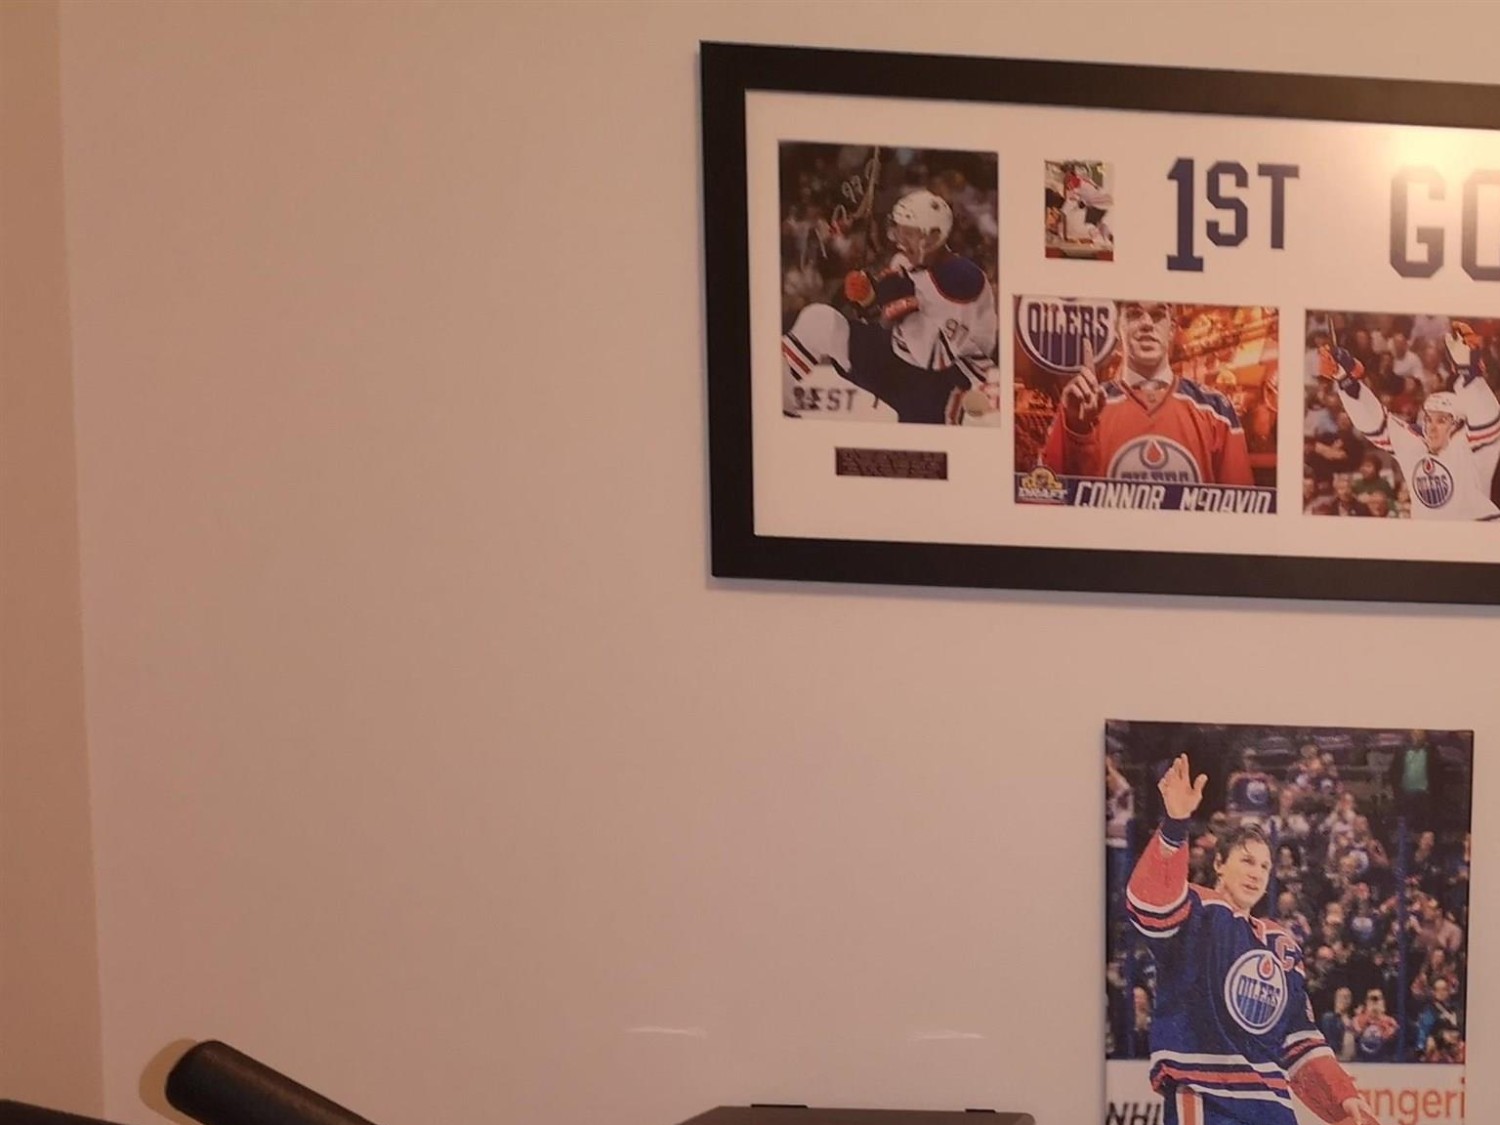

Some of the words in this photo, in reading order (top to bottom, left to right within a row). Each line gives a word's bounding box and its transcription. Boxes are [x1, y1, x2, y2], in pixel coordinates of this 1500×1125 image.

[1166, 157, 1299, 272] 1ST
[1027, 302, 1109, 341] OILERS
[1074, 481, 1167, 510] CONNOR
